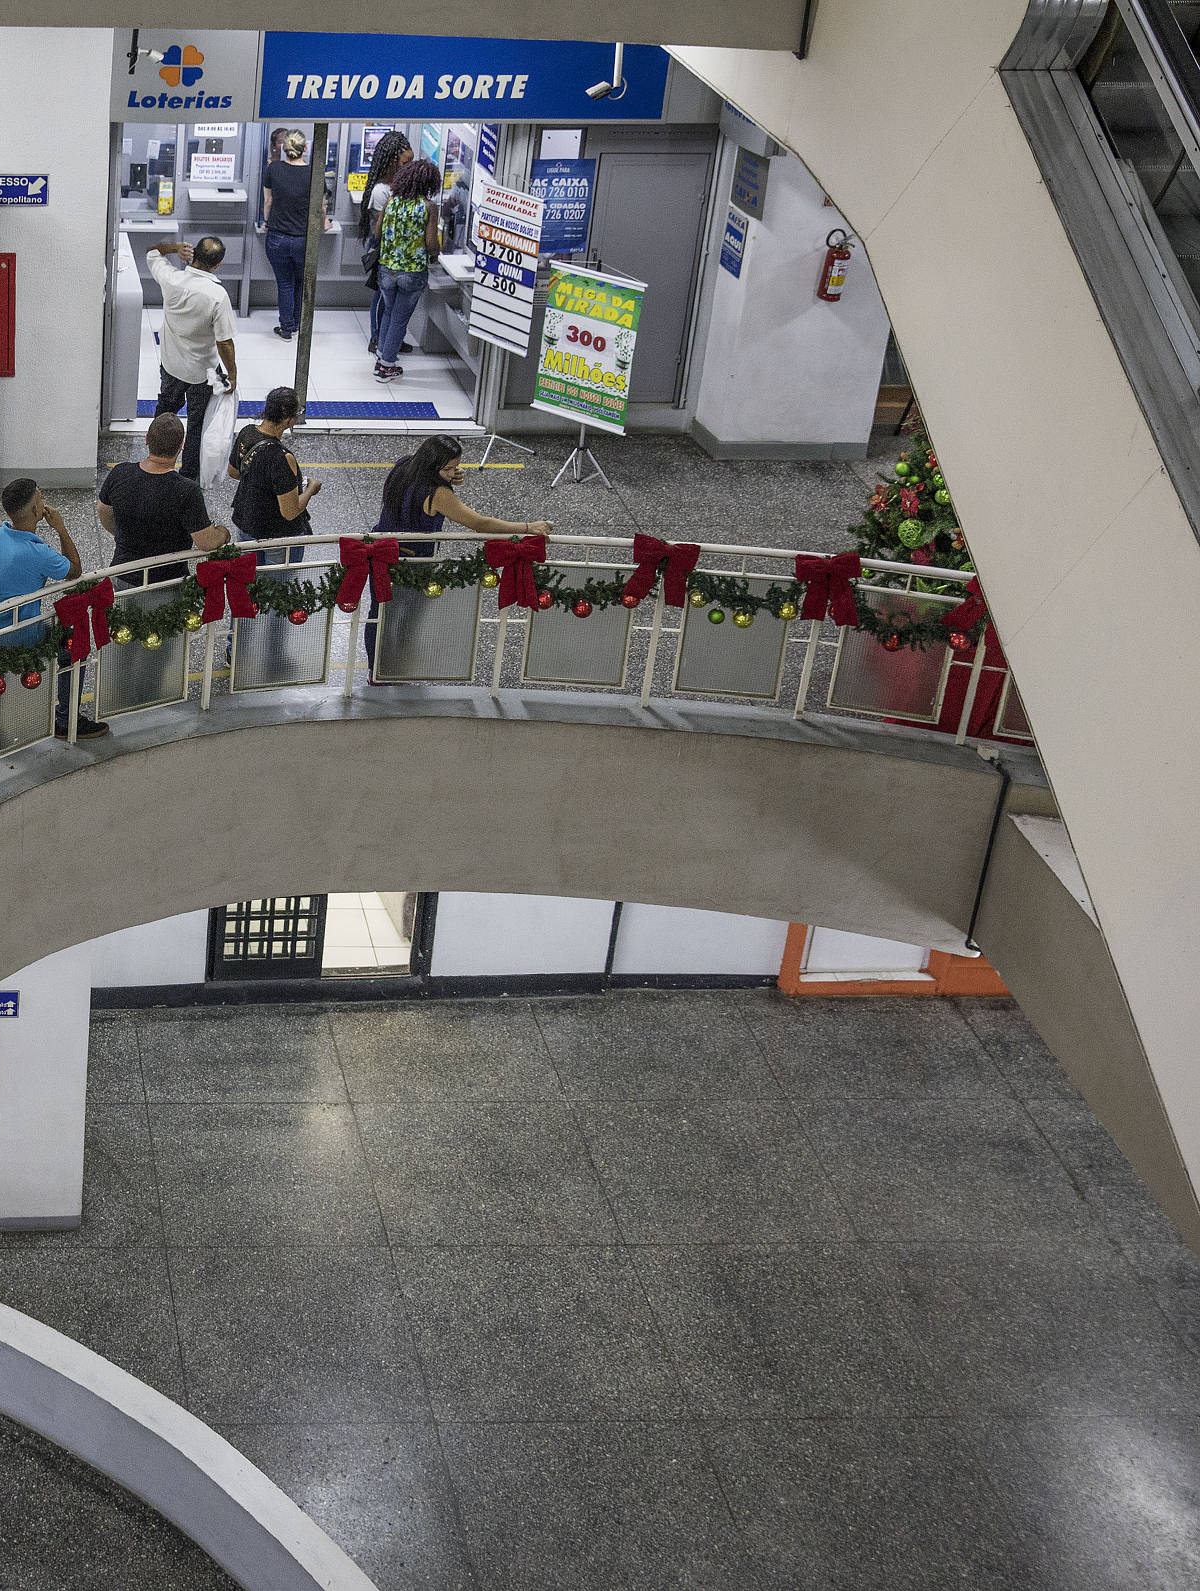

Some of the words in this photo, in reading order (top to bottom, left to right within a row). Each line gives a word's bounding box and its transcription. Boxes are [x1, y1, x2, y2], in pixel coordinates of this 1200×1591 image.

[286, 74, 379, 100] TREVO
[385, 74, 424, 100] DA
[434, 74, 529, 100] SORTE
[127, 91, 232, 110] Loterias
[531, 178, 548, 187] AC
[551, 178, 588, 187] CAIXA
[548, 186, 565, 198] 726
[567, 186, 589, 198] 0101
[486, 188, 518, 203] SORTEIO
[520, 199, 538, 210] HOJE
[486, 196, 537, 218] ACUMULADAS
[549, 202, 586, 210] CIDADÃO
[481, 212, 500, 226] PARTICIPE
[545, 209, 561, 220] 726
[563, 209, 586, 220] 0207
[491, 228, 537, 255] LOTOMANIA
[498, 262, 523, 282] QUINA
[556, 281, 607, 304] MEGA
[611, 295, 636, 312] DA
[554, 293, 633, 329] VIRADA
[566, 325, 607, 352] 300
[543, 347, 628, 391] Milhões
[580, 386, 601, 405] NOSSOS
